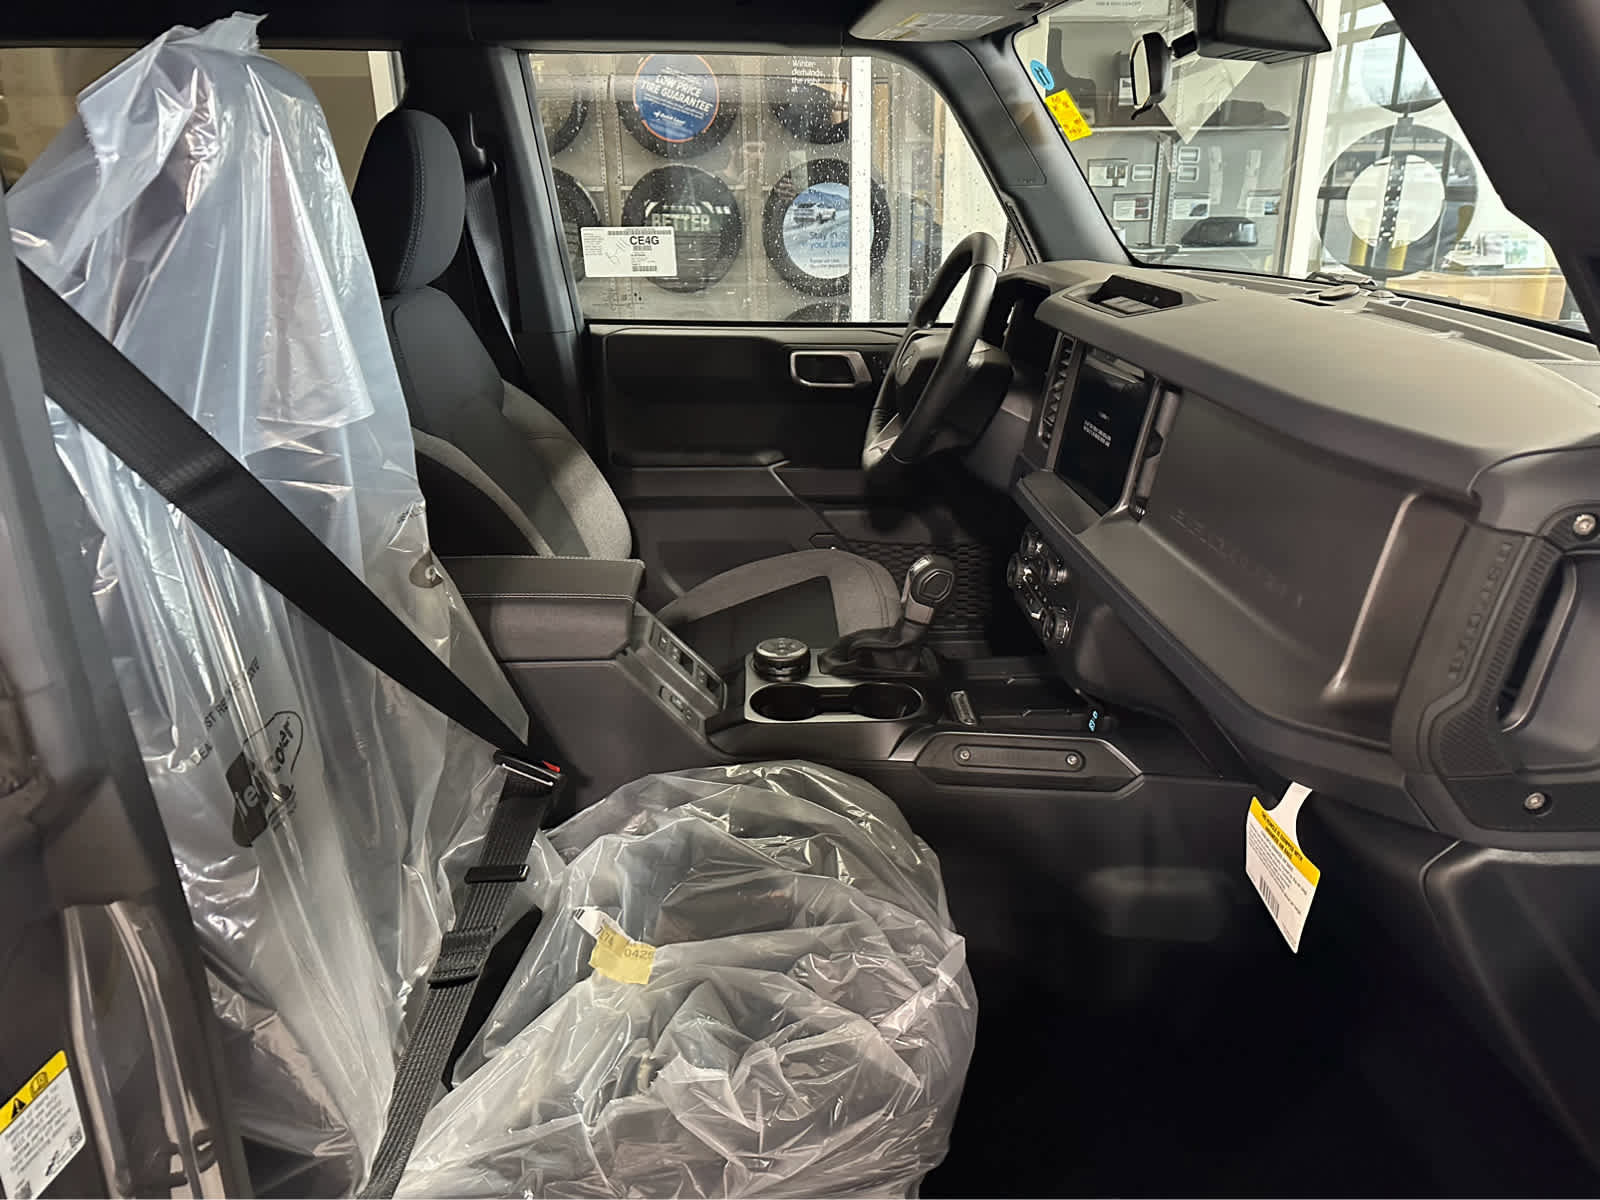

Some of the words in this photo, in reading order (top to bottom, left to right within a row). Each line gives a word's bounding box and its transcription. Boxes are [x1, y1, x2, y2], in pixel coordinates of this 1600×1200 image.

[676, 81, 703, 98] PRICE
[661, 87, 714, 113] GUARANTEE
[651, 213, 711, 232] BETTER
[629, 235, 660, 246] CE4G
